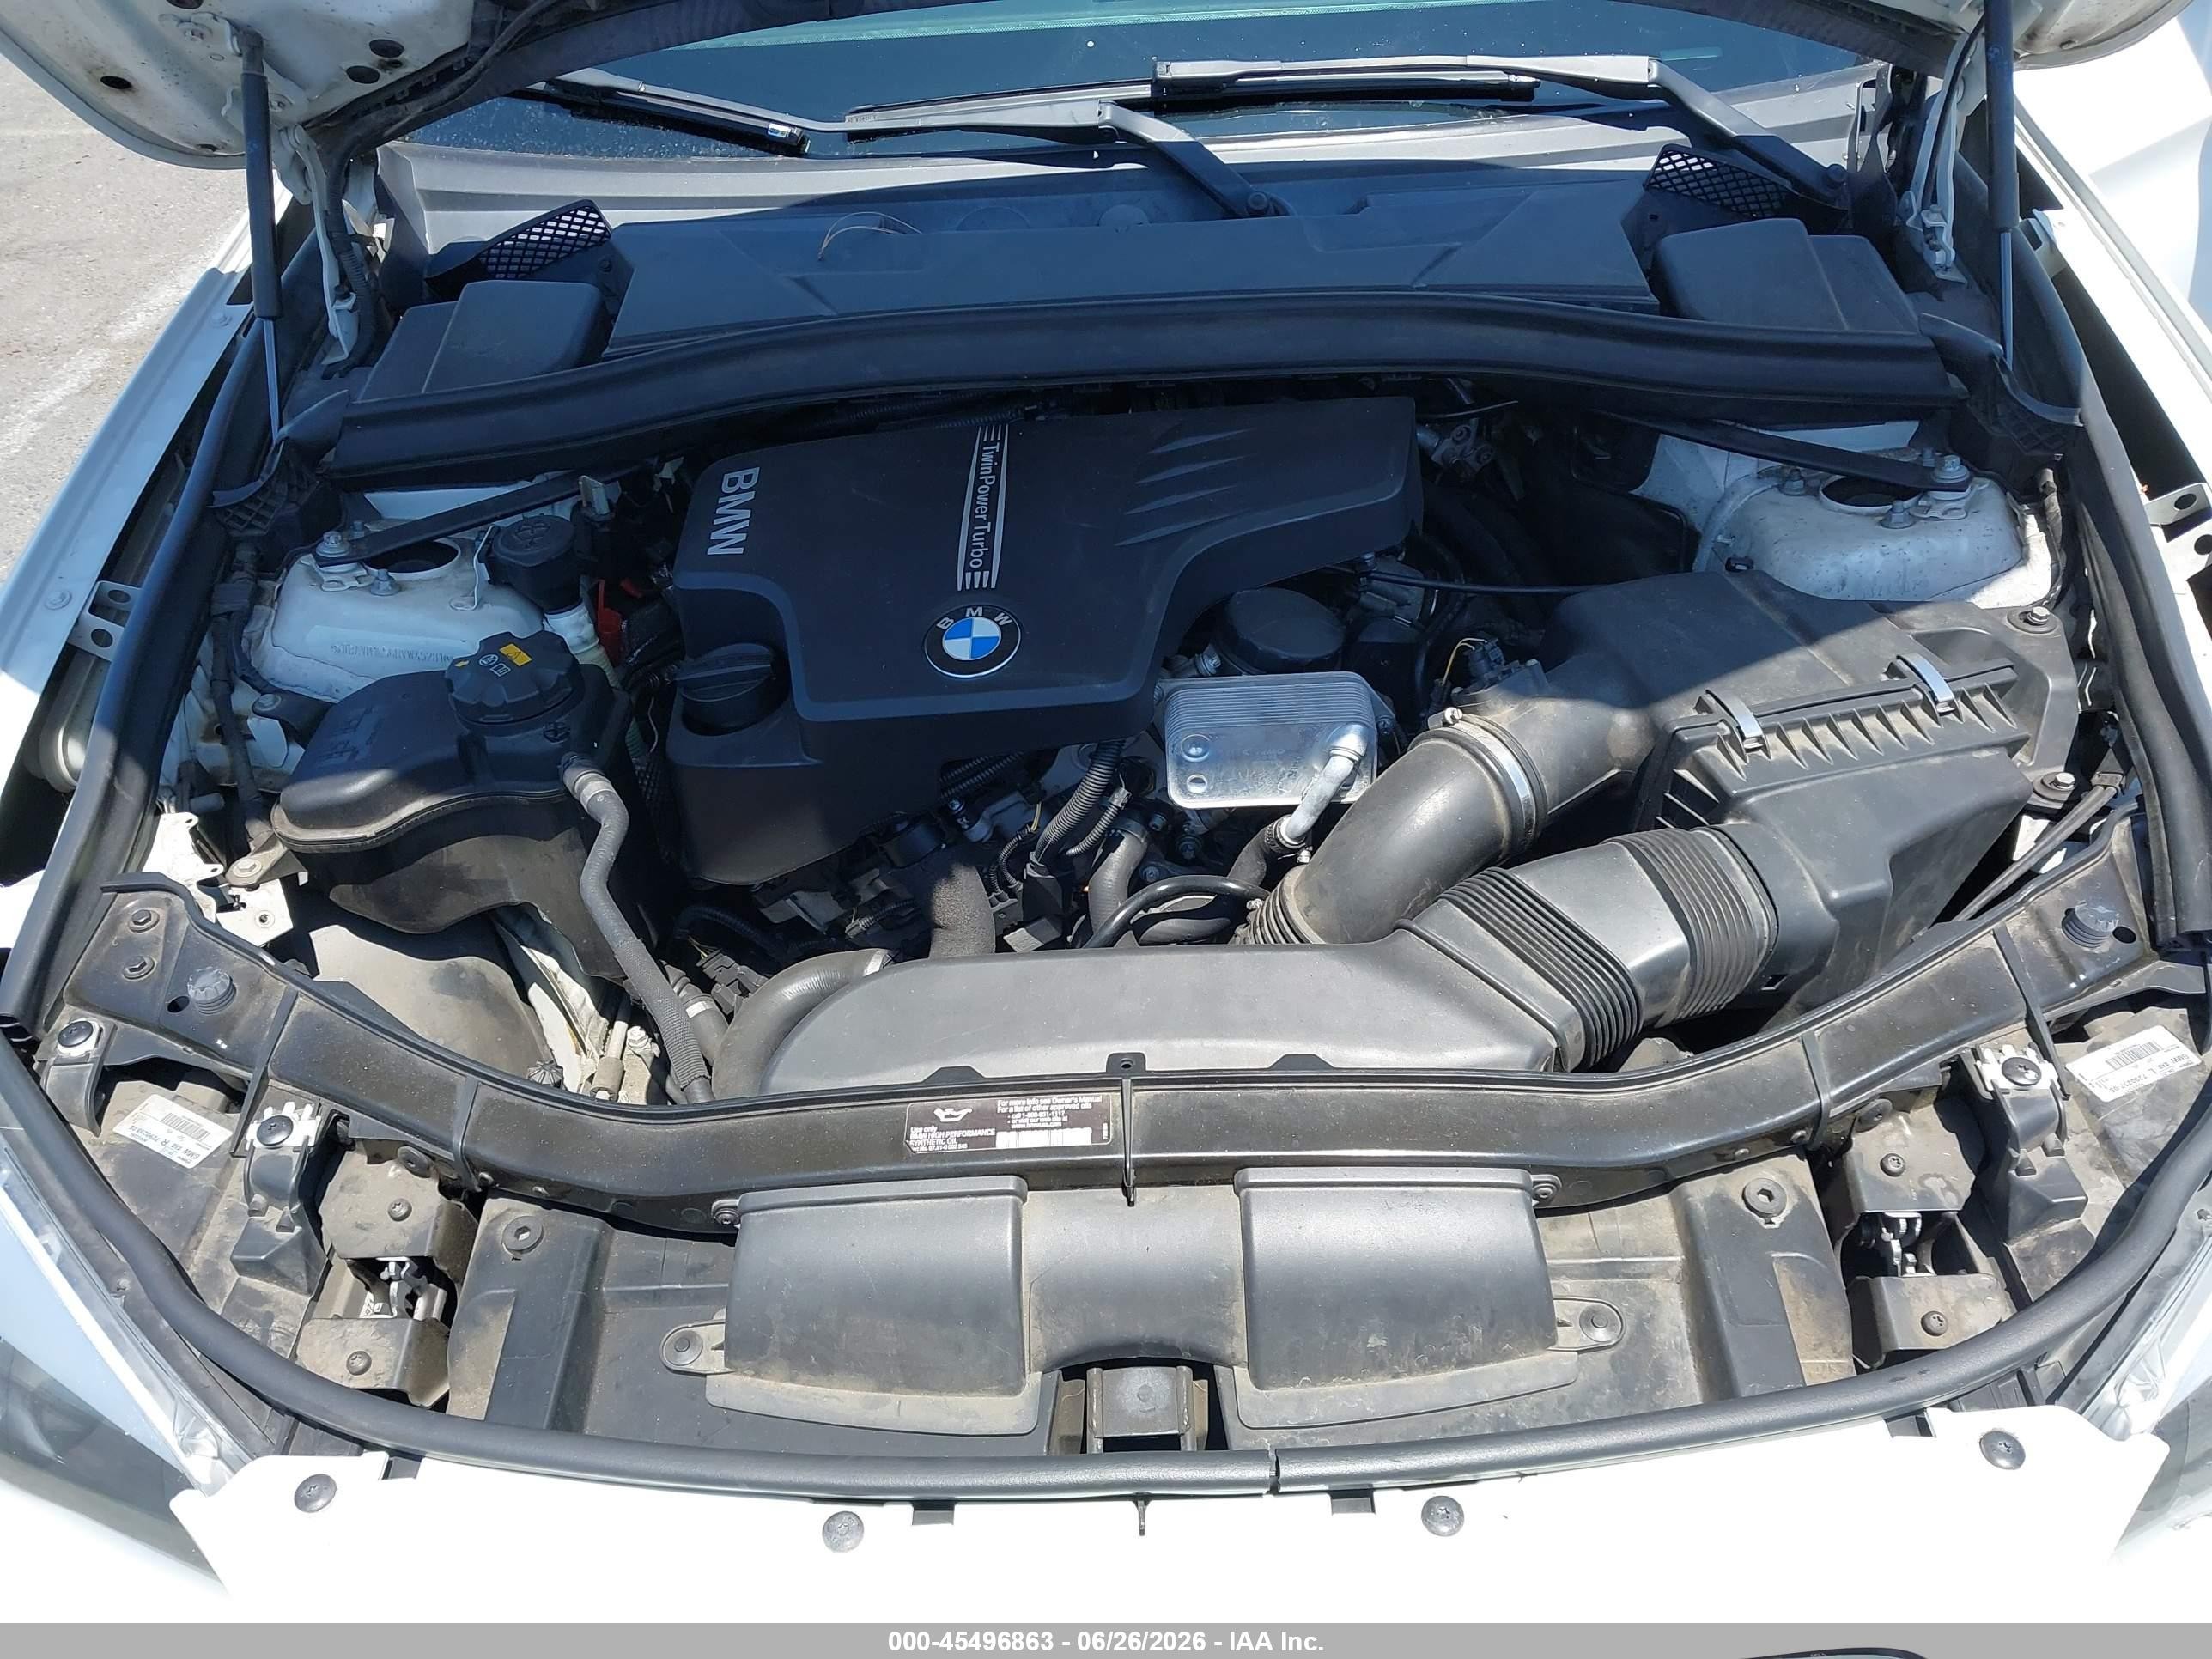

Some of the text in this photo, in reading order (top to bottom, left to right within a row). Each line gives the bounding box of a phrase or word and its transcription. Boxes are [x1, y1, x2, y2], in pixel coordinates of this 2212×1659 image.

[969, 441, 1000, 568] TwinPower Turbo
[707, 466, 760, 556] BMW
[936, 606, 1012, 630] BMW
[1052, 1096, 1078, 1104] Owner's
[1049, 1103, 1080, 1111] approved
[923, 1125, 938, 1133] only
[927, 1131, 945, 1139] HIGH
[945, 1128, 996, 1139] PERFORMANCE
[909, 1138, 945, 1146] SYNTHETIC
